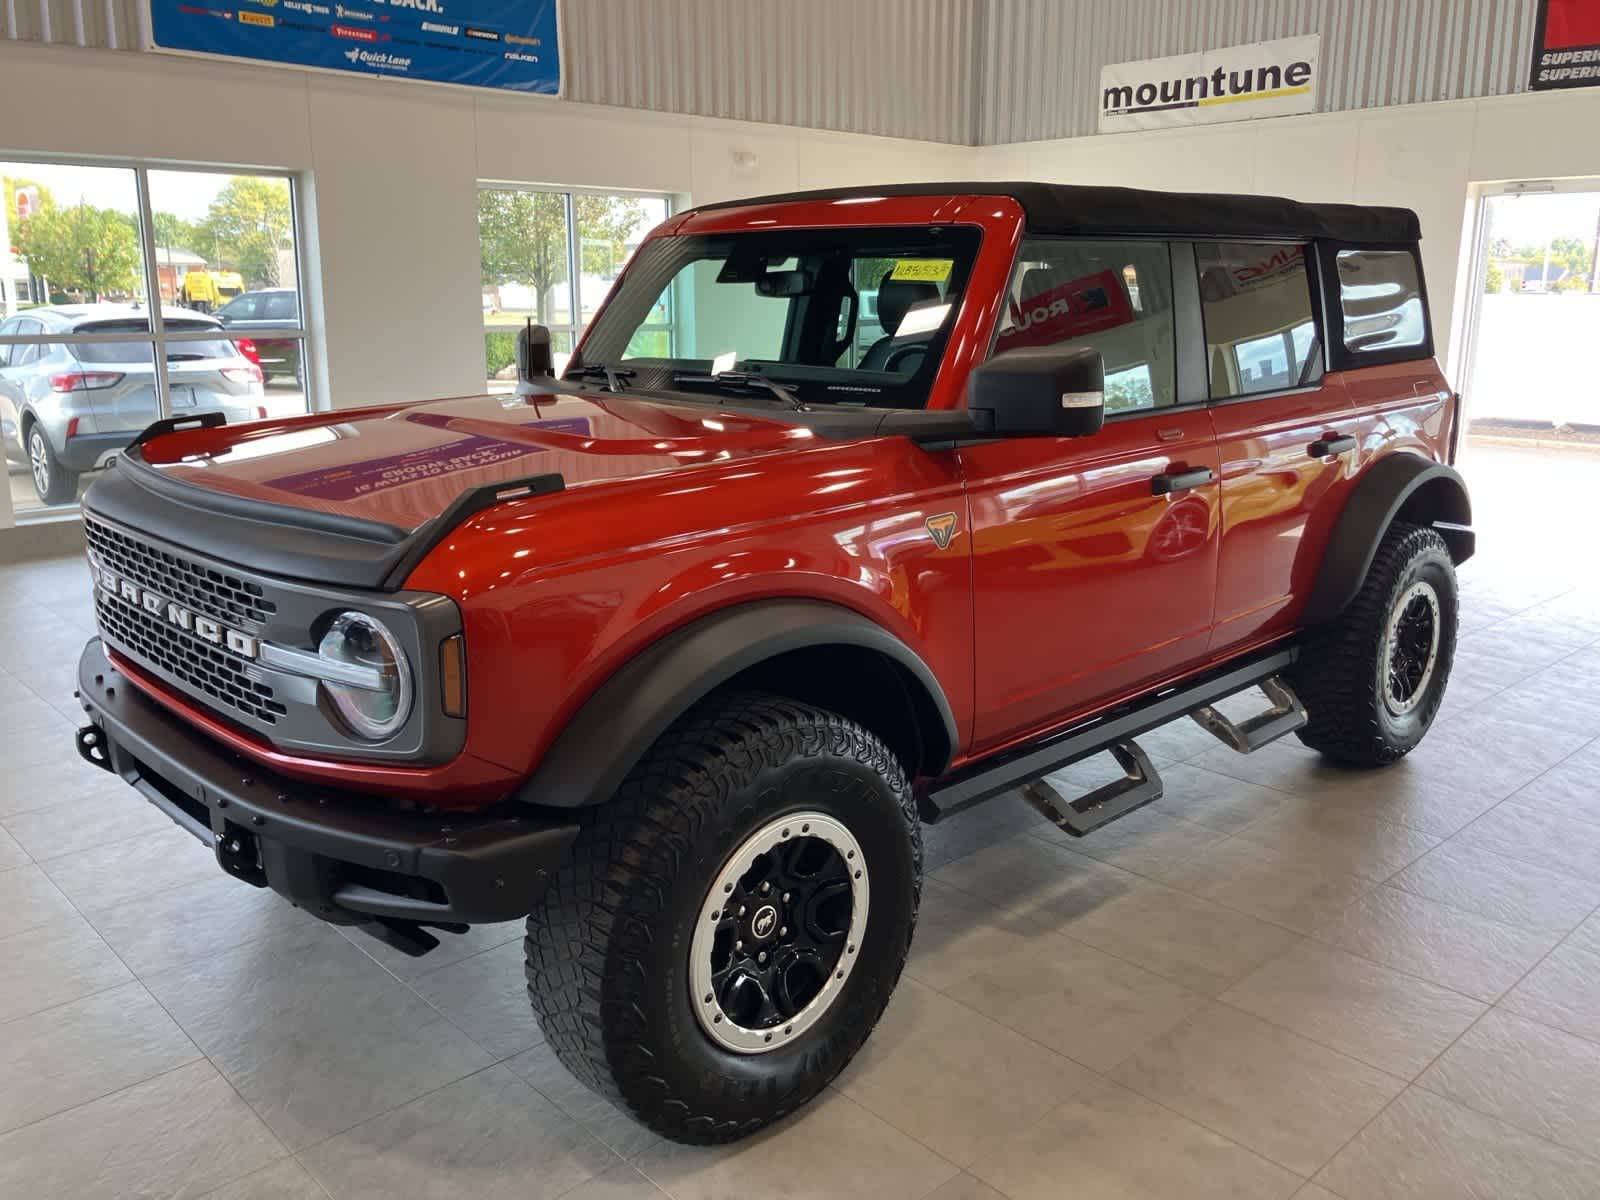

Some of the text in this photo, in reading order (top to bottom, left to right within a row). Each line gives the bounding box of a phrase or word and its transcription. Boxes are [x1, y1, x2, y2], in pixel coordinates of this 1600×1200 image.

[360, 50, 411, 66] Quick Lane
[1541, 50, 1600, 65] SUPERI
[1103, 61, 1312, 110] mountune
[100, 569, 257, 657] BRONCO
